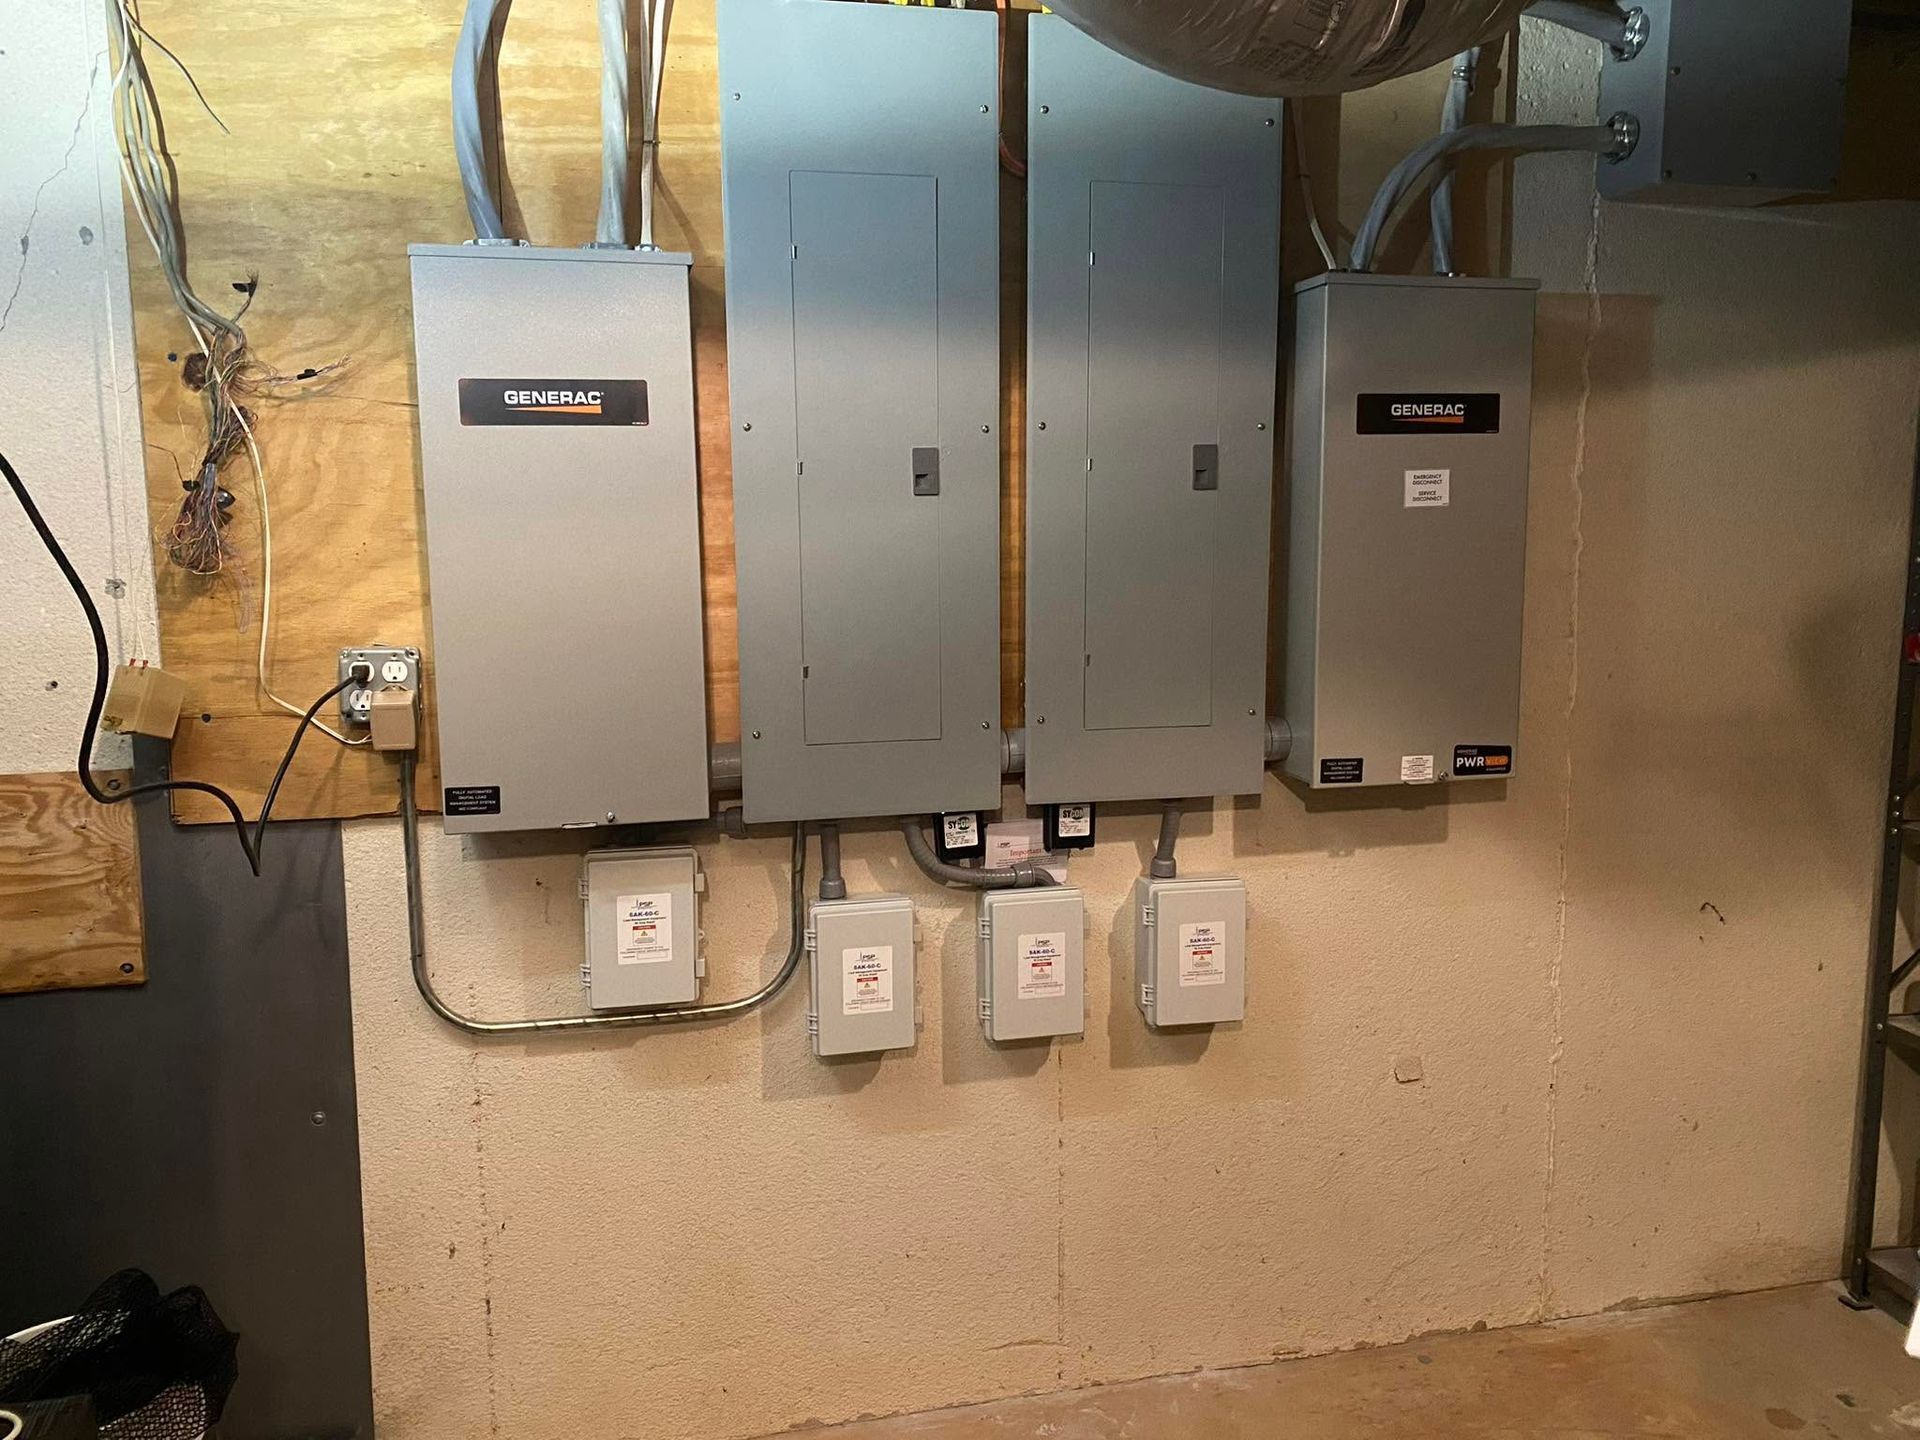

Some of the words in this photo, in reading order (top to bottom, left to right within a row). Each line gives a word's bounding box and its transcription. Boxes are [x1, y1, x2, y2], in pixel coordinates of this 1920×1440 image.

[503, 390, 602, 405] GENERAC
[1391, 403, 1465, 416] GENERAC
[629, 910, 660, 918] SAK-60-C
[1190, 936, 1216, 944] SAK-60-C
[854, 962, 881, 970] SAK-60-C
